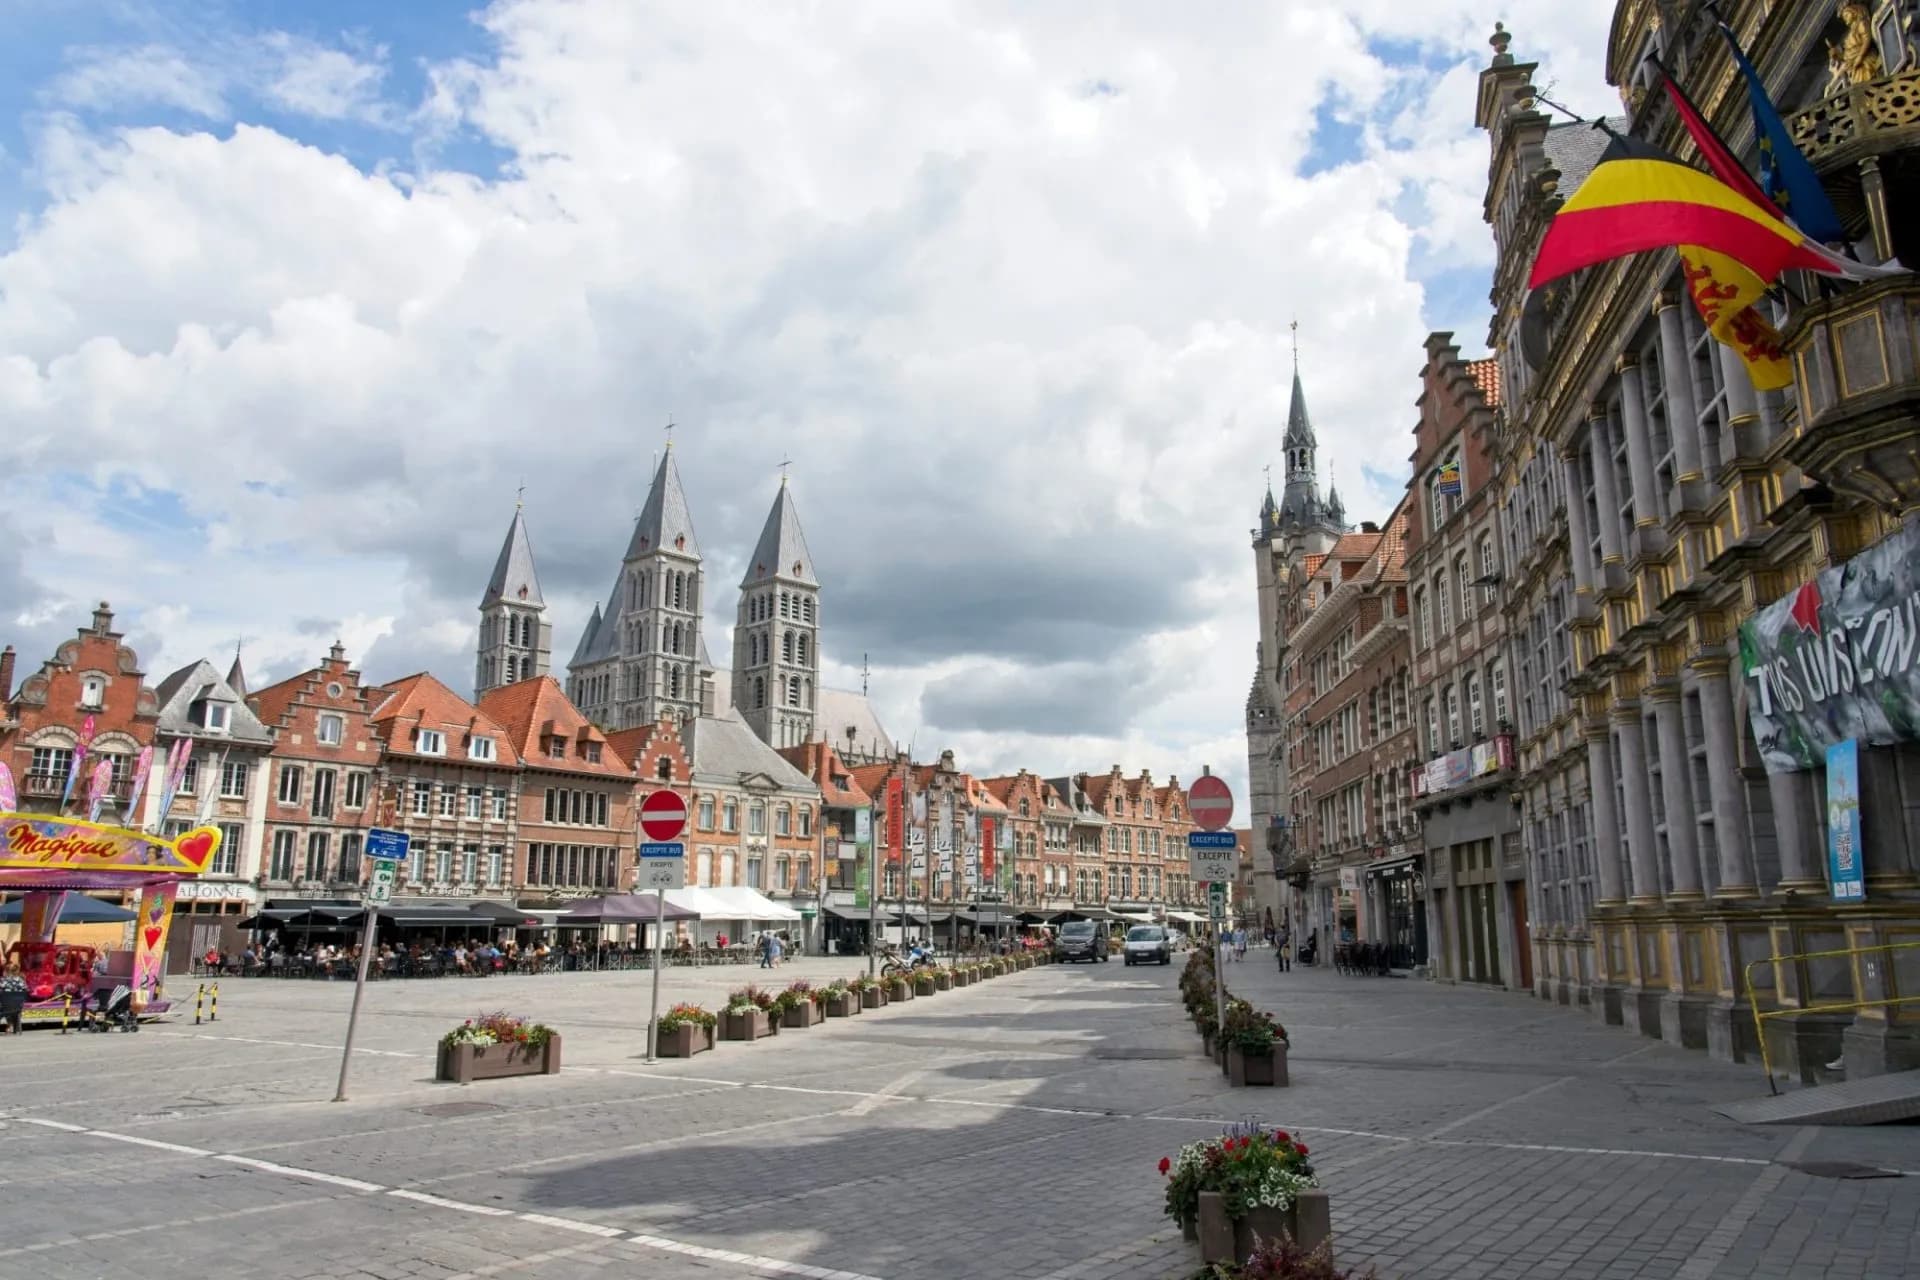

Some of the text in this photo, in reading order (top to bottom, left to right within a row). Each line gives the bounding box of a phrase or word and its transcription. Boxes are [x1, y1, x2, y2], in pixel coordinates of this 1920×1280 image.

[1845, 590, 1920, 685] CON
[7, 822, 119, 863] Magique
[1191, 836, 1220, 844] EXCEPTE
[1198, 851, 1232, 860] EXCEPTE
